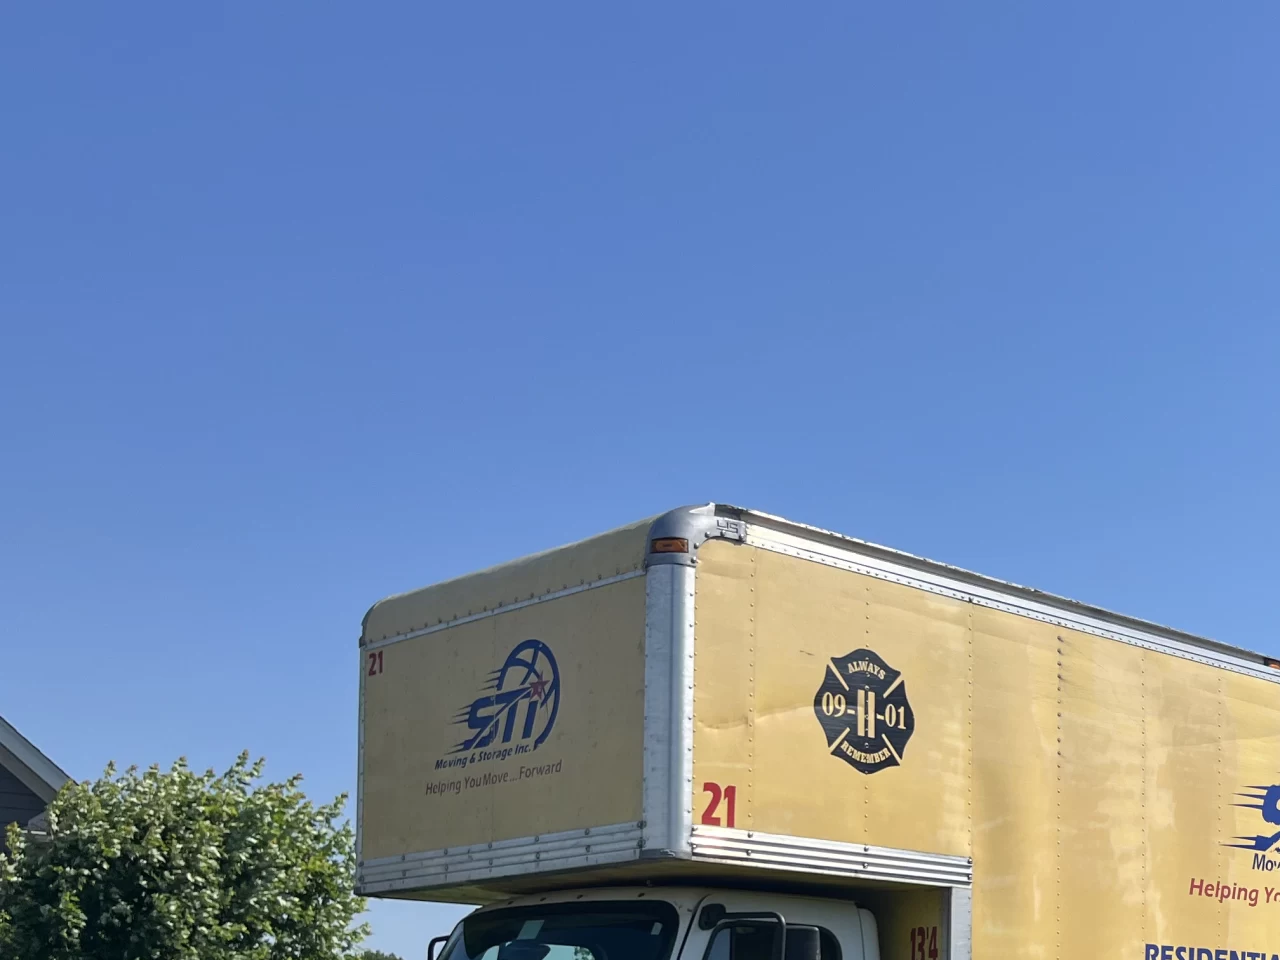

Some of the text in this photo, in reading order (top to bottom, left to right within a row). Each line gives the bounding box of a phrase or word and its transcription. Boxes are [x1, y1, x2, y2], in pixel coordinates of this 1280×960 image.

[368, 650, 384, 677] 21
[847, 660, 886, 680] ALWAYS
[434, 742, 531, 770] Moving & Storage Inc.
[840, 740, 892, 764] REMEMBER
[425, 780, 462, 796] Helping
[464, 776, 482, 790] You
[519, 758, 563, 779] Forward
[701, 782, 737, 829] 21
[1189, 877, 1259, 907] Helping
